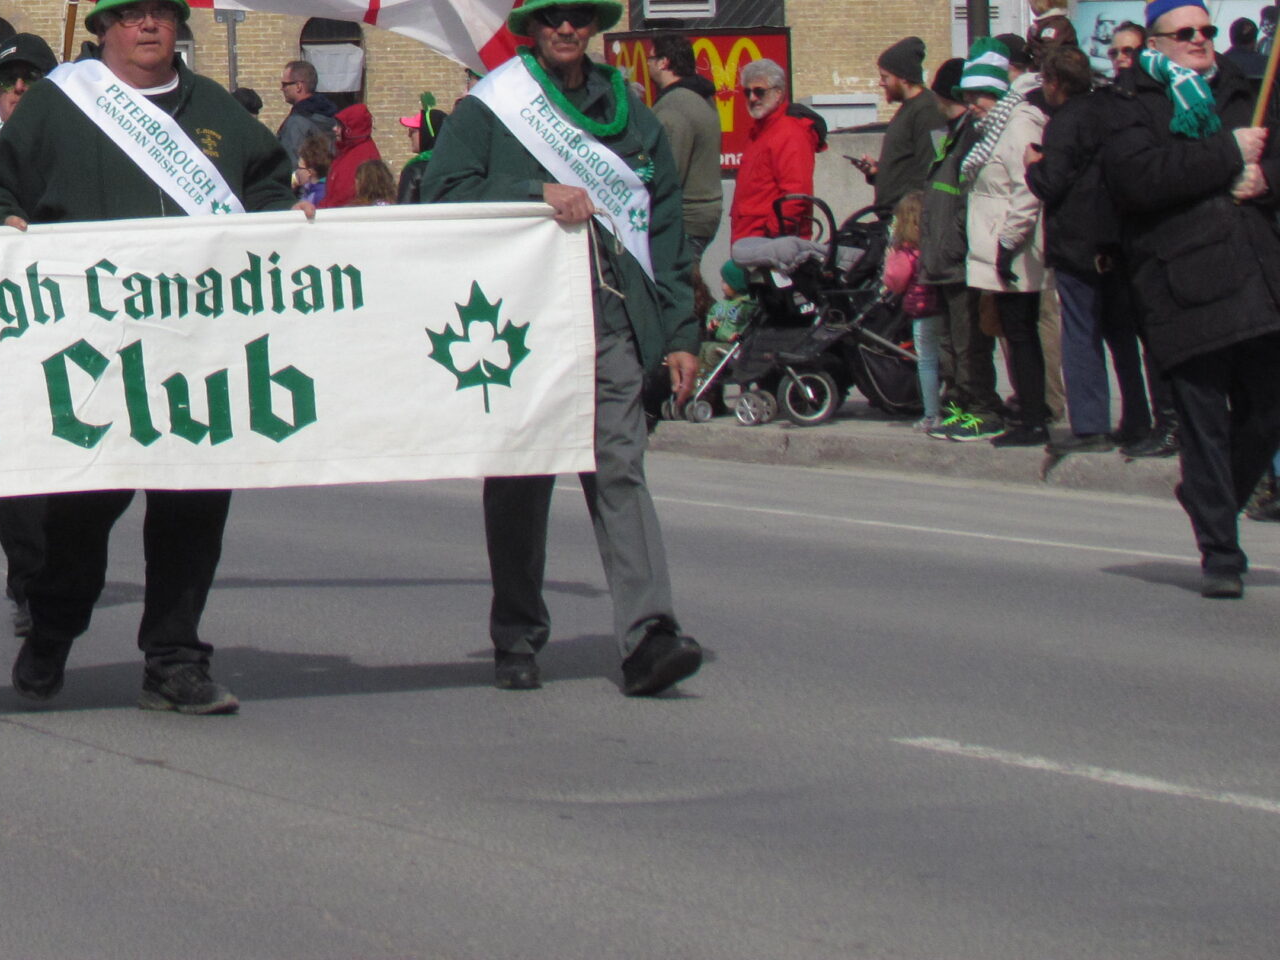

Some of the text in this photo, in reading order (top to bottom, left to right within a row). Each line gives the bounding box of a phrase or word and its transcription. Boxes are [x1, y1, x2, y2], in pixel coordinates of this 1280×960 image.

[96, 95, 205, 206] CANADIAN IRISH CLUB
[105, 84, 216, 196] PETERBOROUGH
[520, 108, 623, 217] CANADIAN IRISH CLUB
[530, 93, 633, 206] PETERBOROUGH
[86, 252, 365, 322] Canadian
[42, 333, 318, 450] Club
